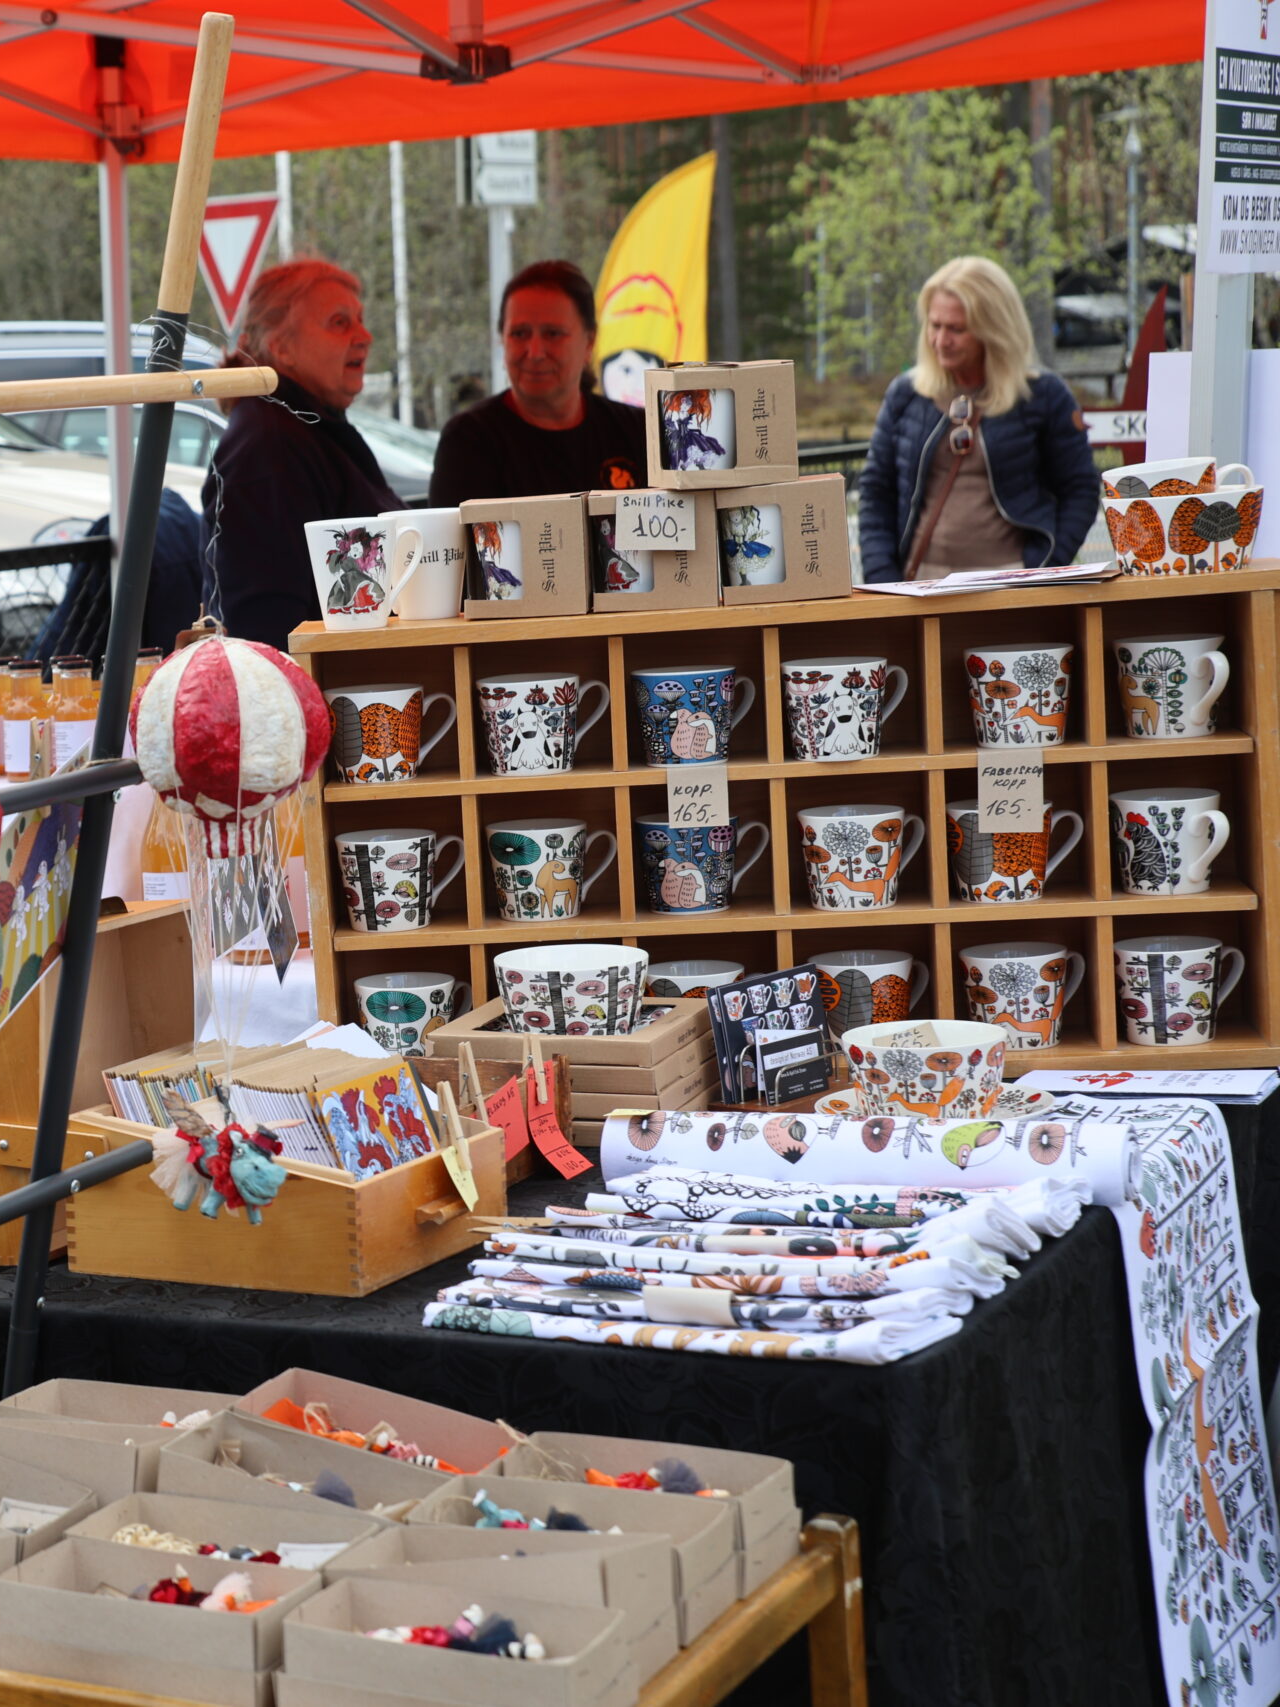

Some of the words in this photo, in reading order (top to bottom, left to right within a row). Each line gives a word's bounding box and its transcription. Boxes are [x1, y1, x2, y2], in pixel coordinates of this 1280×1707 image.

[1219, 56, 1228, 90] EN
[1229, 57, 1271, 94] KULTURREISE
[1275, 62, 1280, 96] S
[1223, 195, 1238, 221] KOM
[1241, 196, 1249, 221] OG
[1251, 196, 1272, 221] BESØK
[1220, 229, 1280, 254] WWW.SKOGINGER.N
[623, 495, 650, 508] Snill
[655, 494, 685, 509] Pike
[632, 513, 687, 542] 100,-
[673, 802, 718, 824] 165,-
